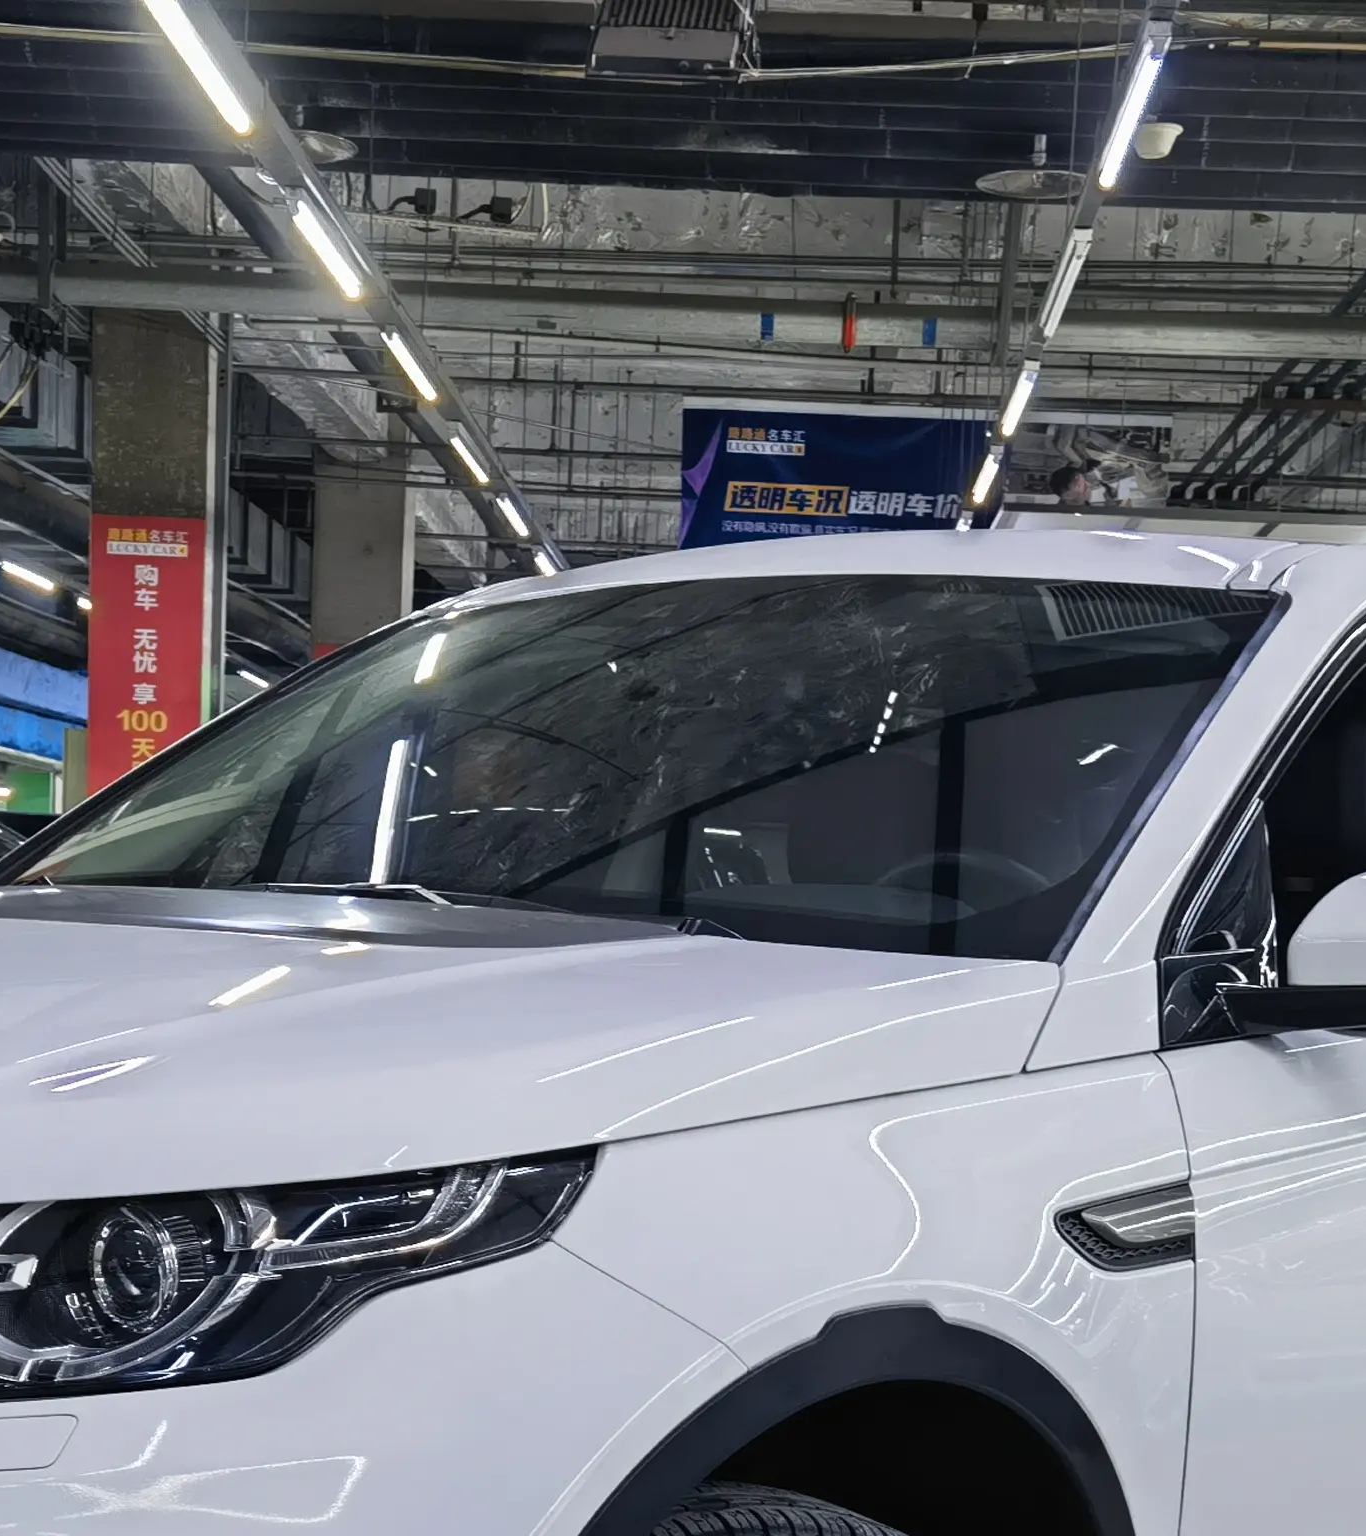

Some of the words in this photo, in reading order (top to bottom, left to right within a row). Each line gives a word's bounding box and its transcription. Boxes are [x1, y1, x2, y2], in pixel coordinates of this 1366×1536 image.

[728, 441, 767, 453] LUCKY
[770, 443, 794, 454] CAR
[732, 485, 843, 514] 透明车况
[848, 490, 962, 519] 透明车价
[108, 543, 148, 553] LUCKY
[152, 545, 176, 555] CAR
[134, 564, 159, 611] 购车
[132, 628, 158, 674] 无忧
